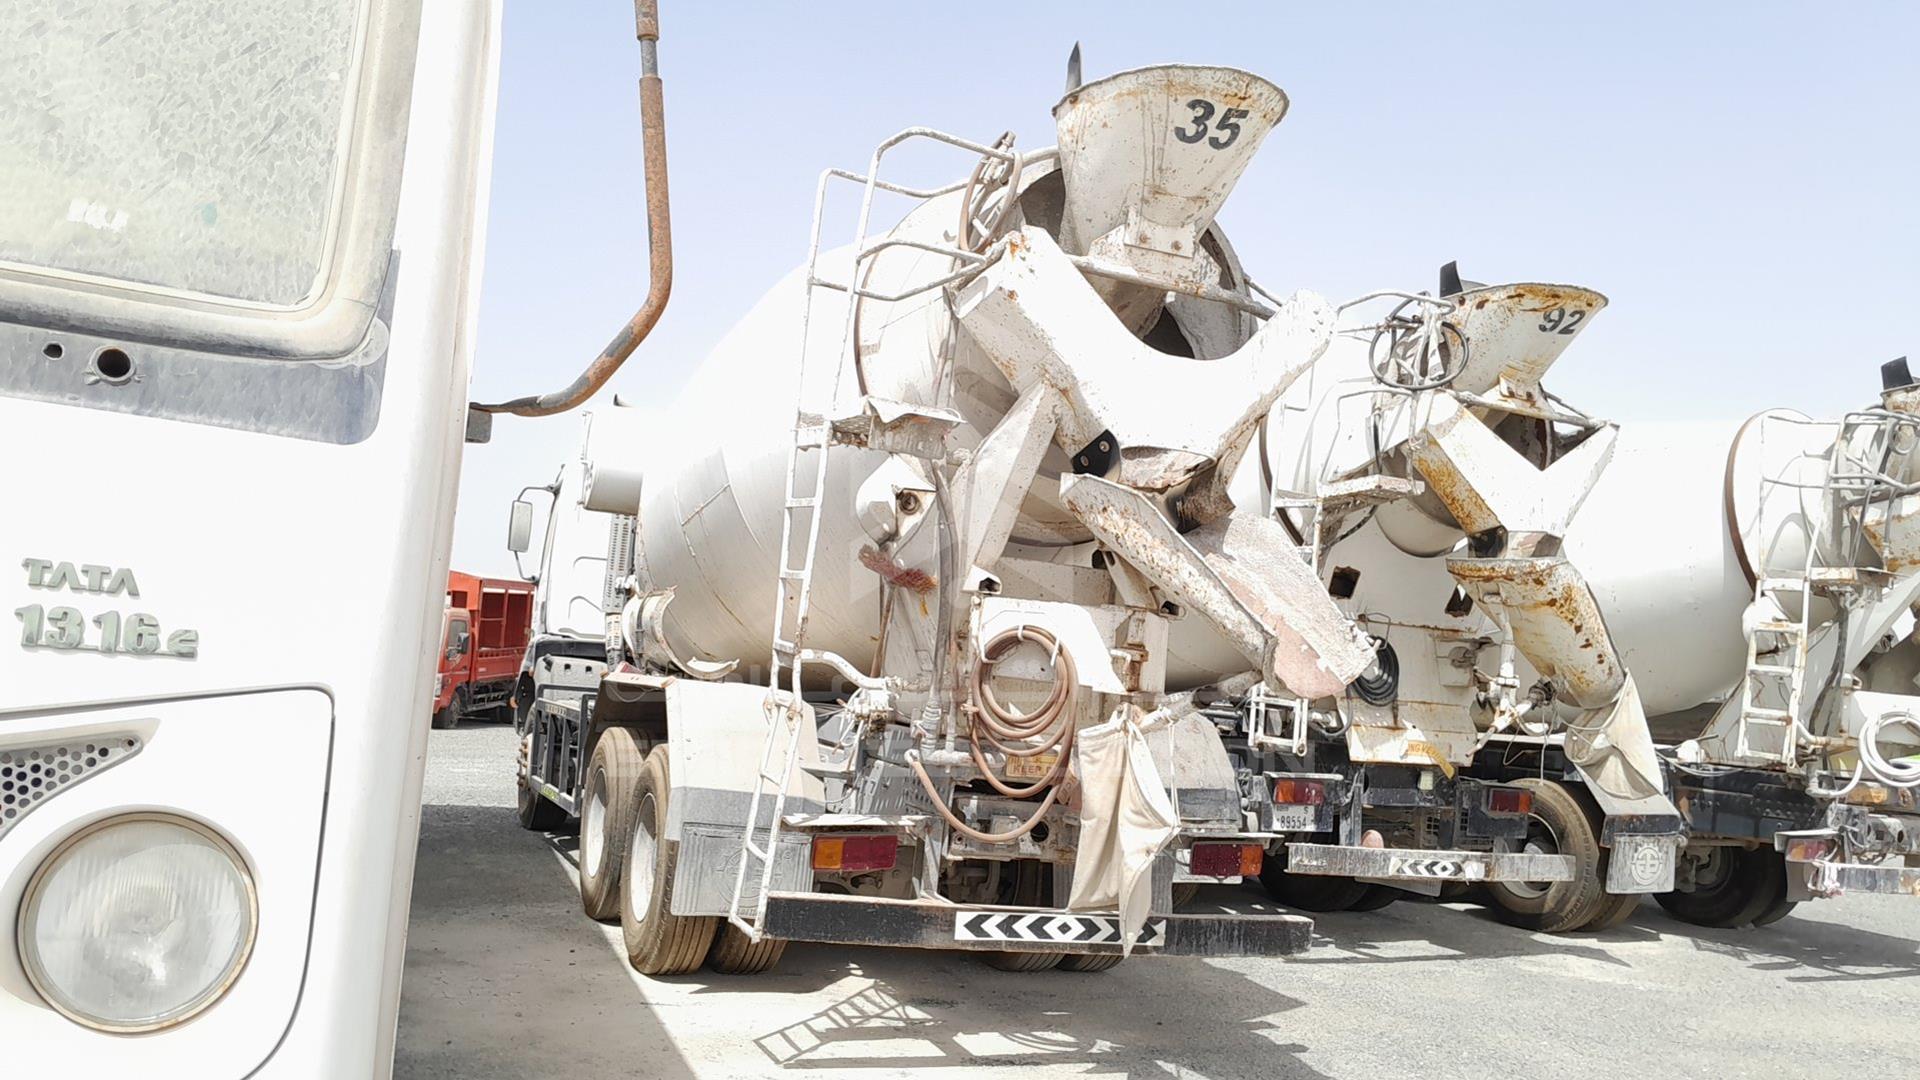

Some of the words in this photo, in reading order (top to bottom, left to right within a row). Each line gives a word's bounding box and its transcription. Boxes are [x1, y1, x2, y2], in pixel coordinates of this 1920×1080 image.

[1174, 99, 1249, 150] 35
[1538, 307, 1586, 335] 92
[21, 558, 140, 597] TATA
[1280, 815, 1307, 829] 89554
